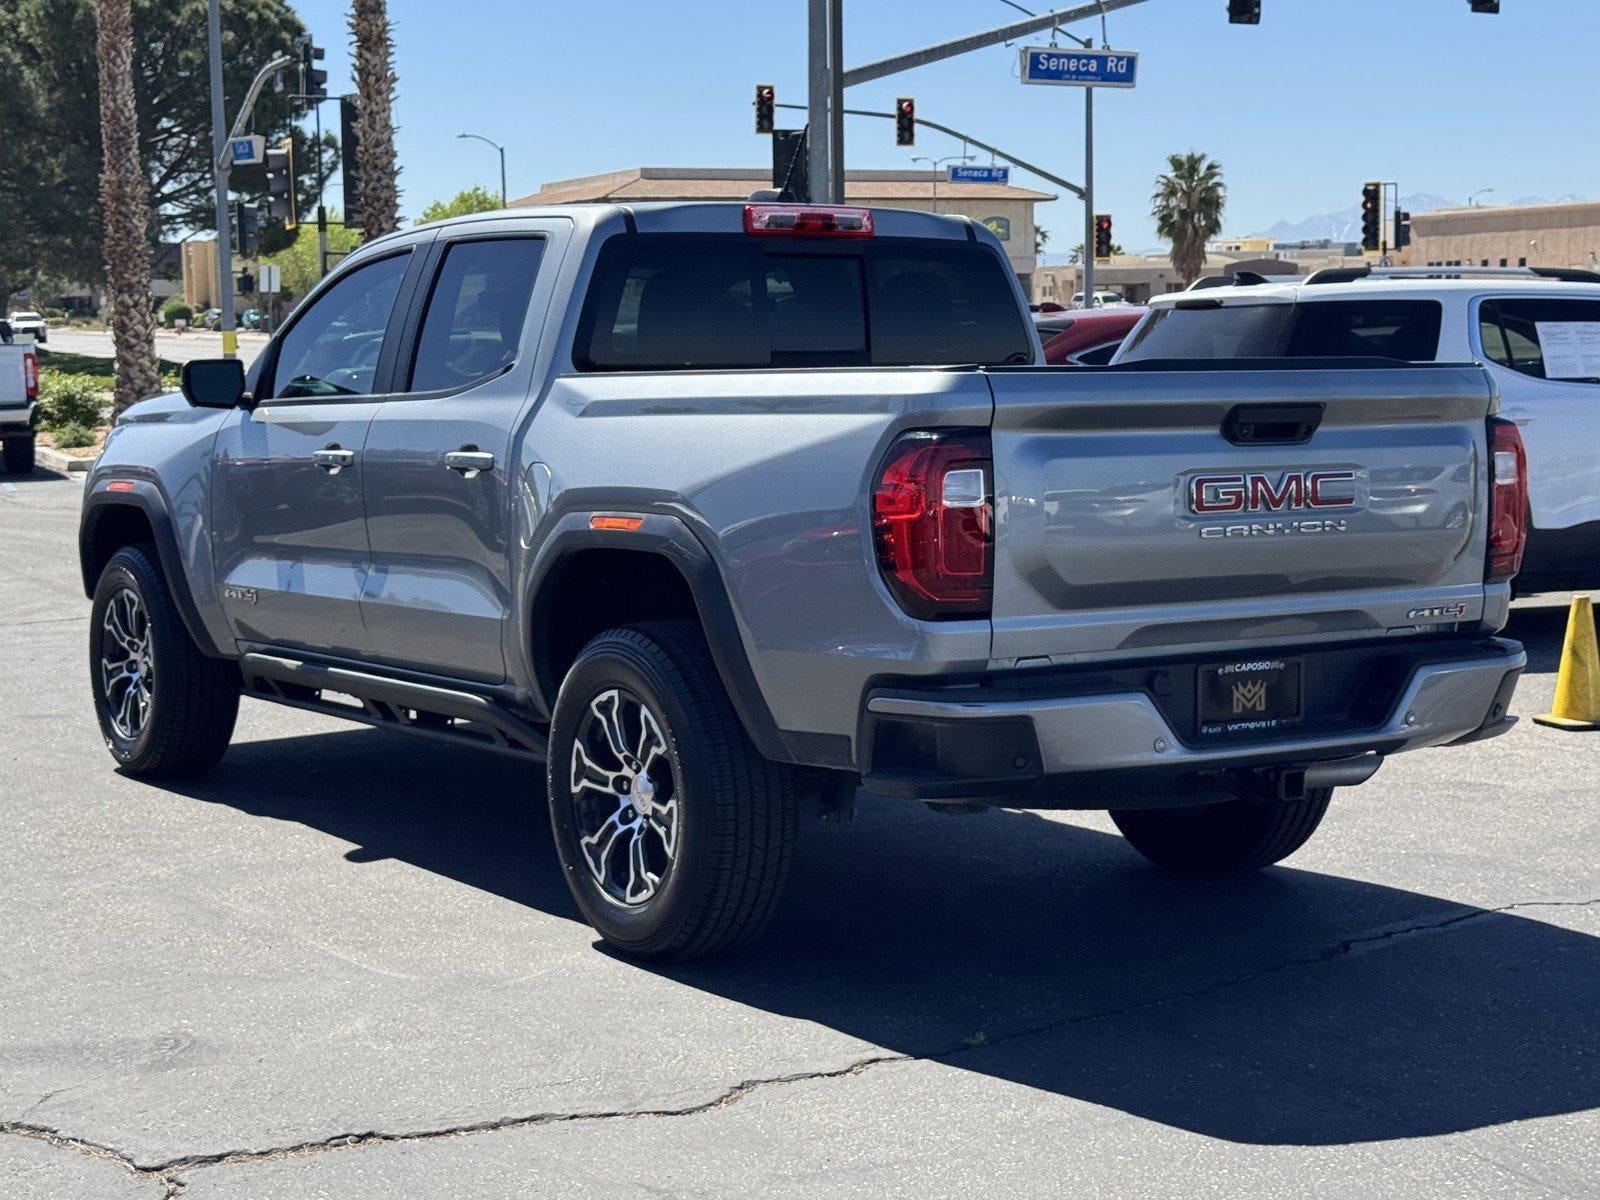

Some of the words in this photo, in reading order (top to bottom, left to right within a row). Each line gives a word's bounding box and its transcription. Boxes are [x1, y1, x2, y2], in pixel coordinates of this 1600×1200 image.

[1038, 53, 1098, 72] Seneca
[1107, 56, 1127, 73] Rd
[956, 168, 989, 178] Seneca
[991, 168, 1004, 178] Rd
[1189, 470, 1356, 514] GMC
[1200, 519, 1347, 539] CANYON
[1407, 603, 1466, 618] AT4
[1235, 661, 1271, 672] CAPOSIO
